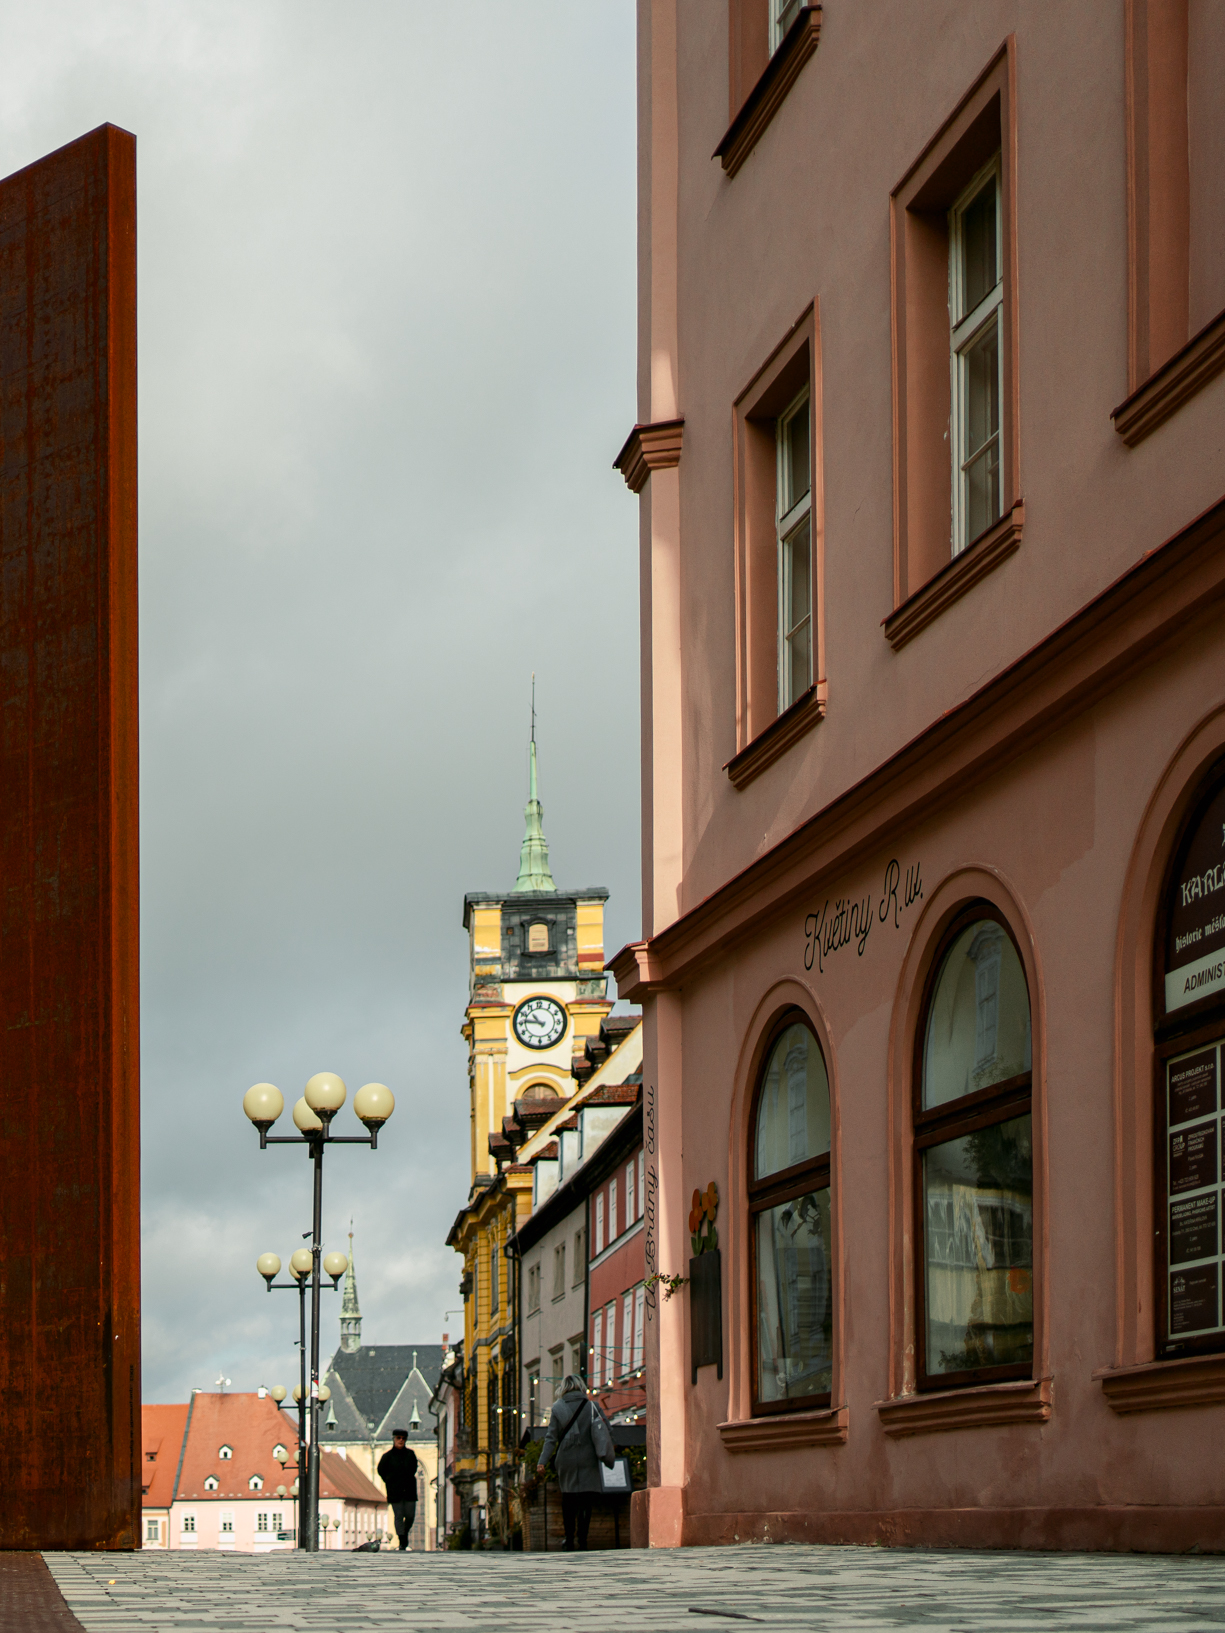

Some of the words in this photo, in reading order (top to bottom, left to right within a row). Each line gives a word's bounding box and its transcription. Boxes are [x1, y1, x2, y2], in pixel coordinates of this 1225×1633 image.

[804, 895, 874, 974] Květiny
[1185, 1064, 1205, 1078] PROJEKT
[644, 1085, 656, 1155] času
[644, 1165, 659, 1274] Brány
